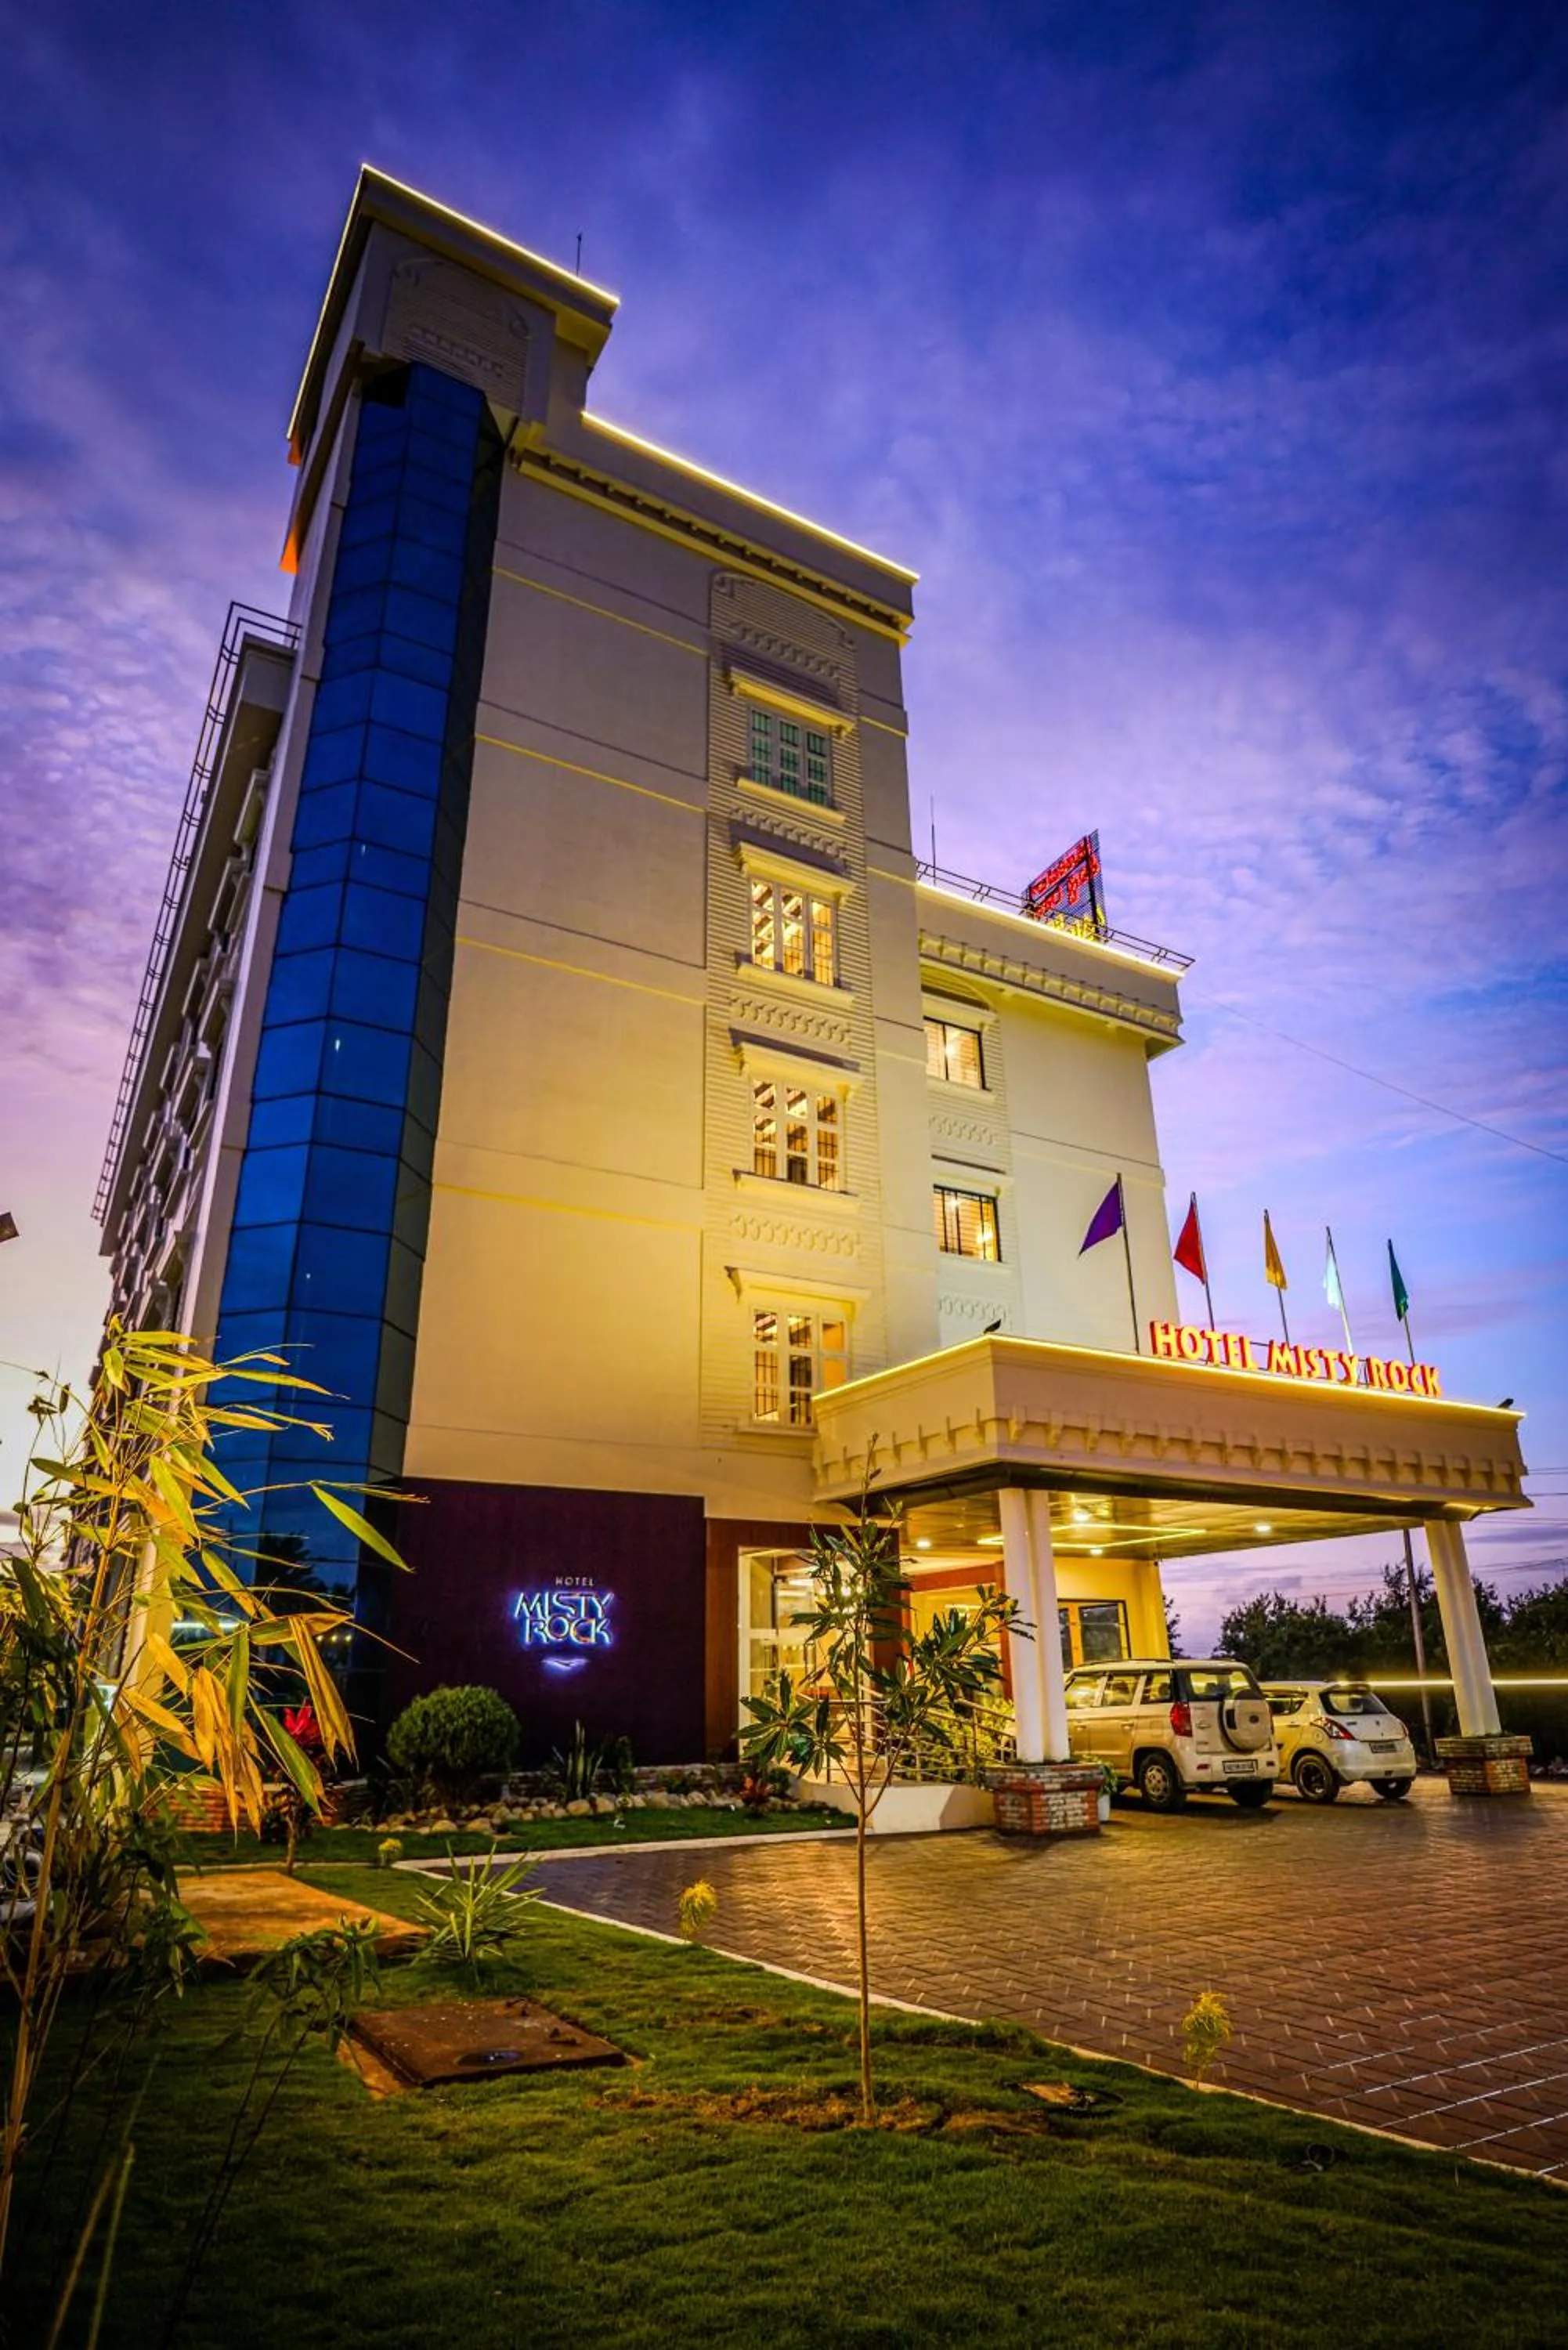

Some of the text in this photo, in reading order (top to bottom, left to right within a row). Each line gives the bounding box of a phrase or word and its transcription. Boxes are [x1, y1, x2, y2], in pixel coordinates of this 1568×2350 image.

[1150, 1321, 1442, 1397] HOTEL MISTY ROCK
[555, 1575, 594, 1587] HOTEL
[514, 1591, 615, 1619] MISTY
[525, 1614, 612, 1645] ROCK
